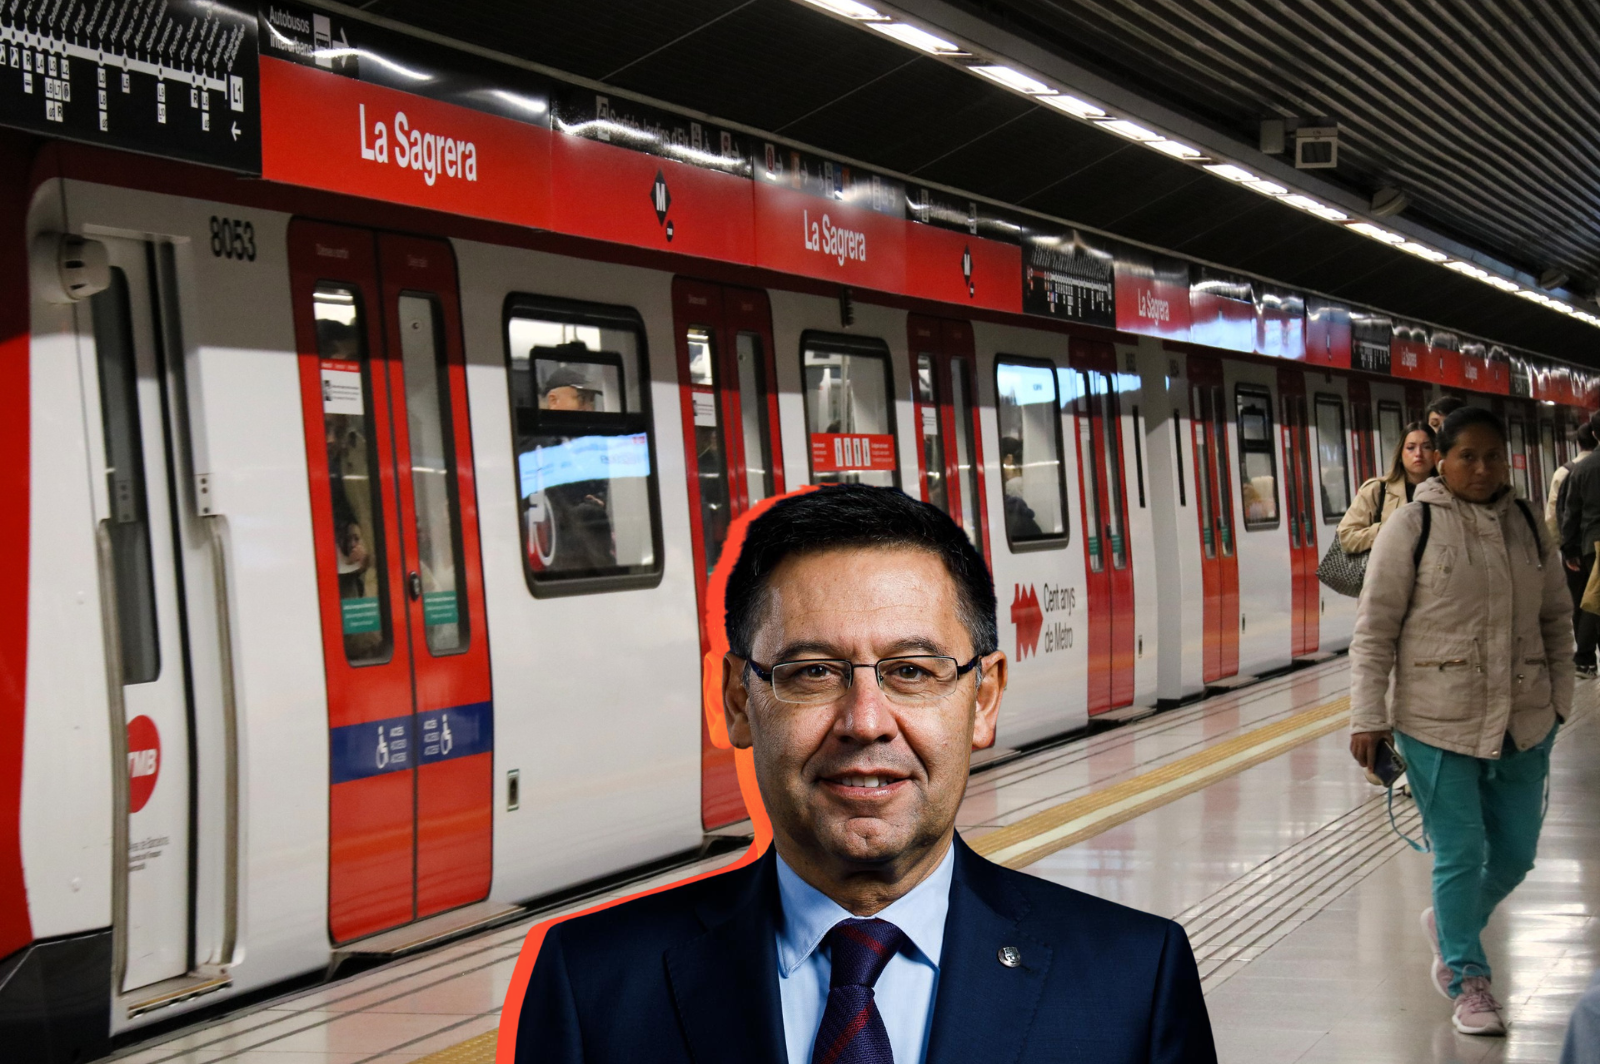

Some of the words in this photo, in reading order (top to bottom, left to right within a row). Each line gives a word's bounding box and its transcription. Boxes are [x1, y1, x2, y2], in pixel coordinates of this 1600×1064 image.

[269, 5, 310, 34] Autobusos
[233, 83, 242, 104] L1
[359, 103, 388, 164] La
[394, 111, 478, 187] Sagrera
[209, 215, 256, 262] 8053
[804, 209, 819, 252] La
[822, 213, 866, 266] Sagrera
[1138, 288, 1147, 317] La
[1147, 290, 1170, 326] Sagrera
[1044, 582, 1060, 613] Cent
[1060, 586, 1076, 616] anys
[1045, 624, 1054, 653] de
[1054, 621, 1074, 652] Metro
